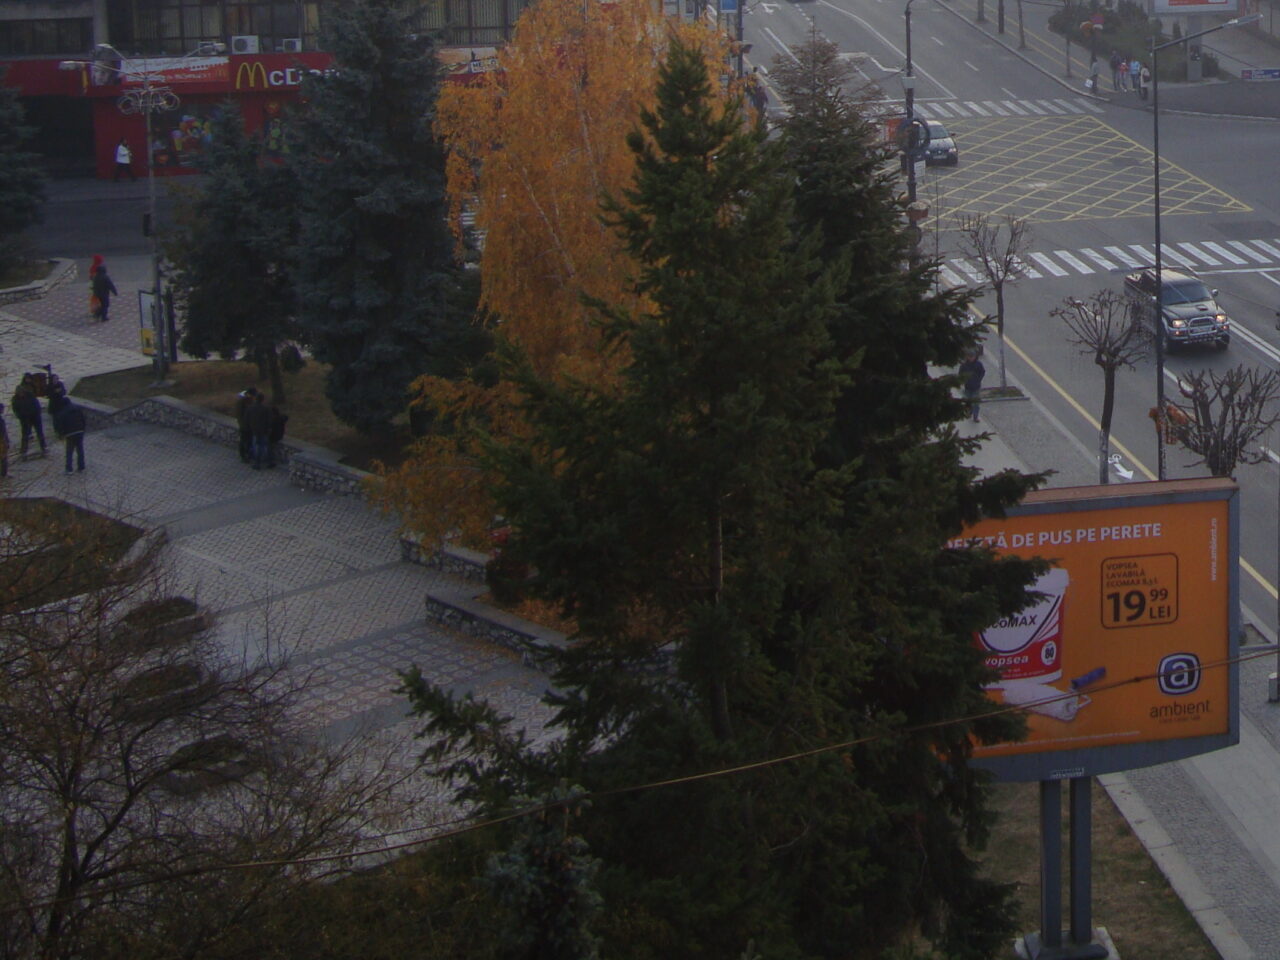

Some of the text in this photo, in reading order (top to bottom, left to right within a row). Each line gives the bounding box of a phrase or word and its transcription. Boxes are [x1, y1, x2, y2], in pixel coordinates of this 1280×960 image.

[1012, 532, 1035, 548] DE
[1038, 529, 1073, 546] PUS
[1076, 527, 1096, 543] PE
[1100, 522, 1162, 541] PERETE
[1105, 562, 1138, 571] VOPSEA
[1150, 588, 1169, 602] 99
[1106, 589, 1146, 623] 19
[1149, 605, 1171, 619] LEI
[1045, 647, 1055, 660] 80
[985, 656, 1028, 667] vopsea
[1149, 700, 1210, 719] ambient
